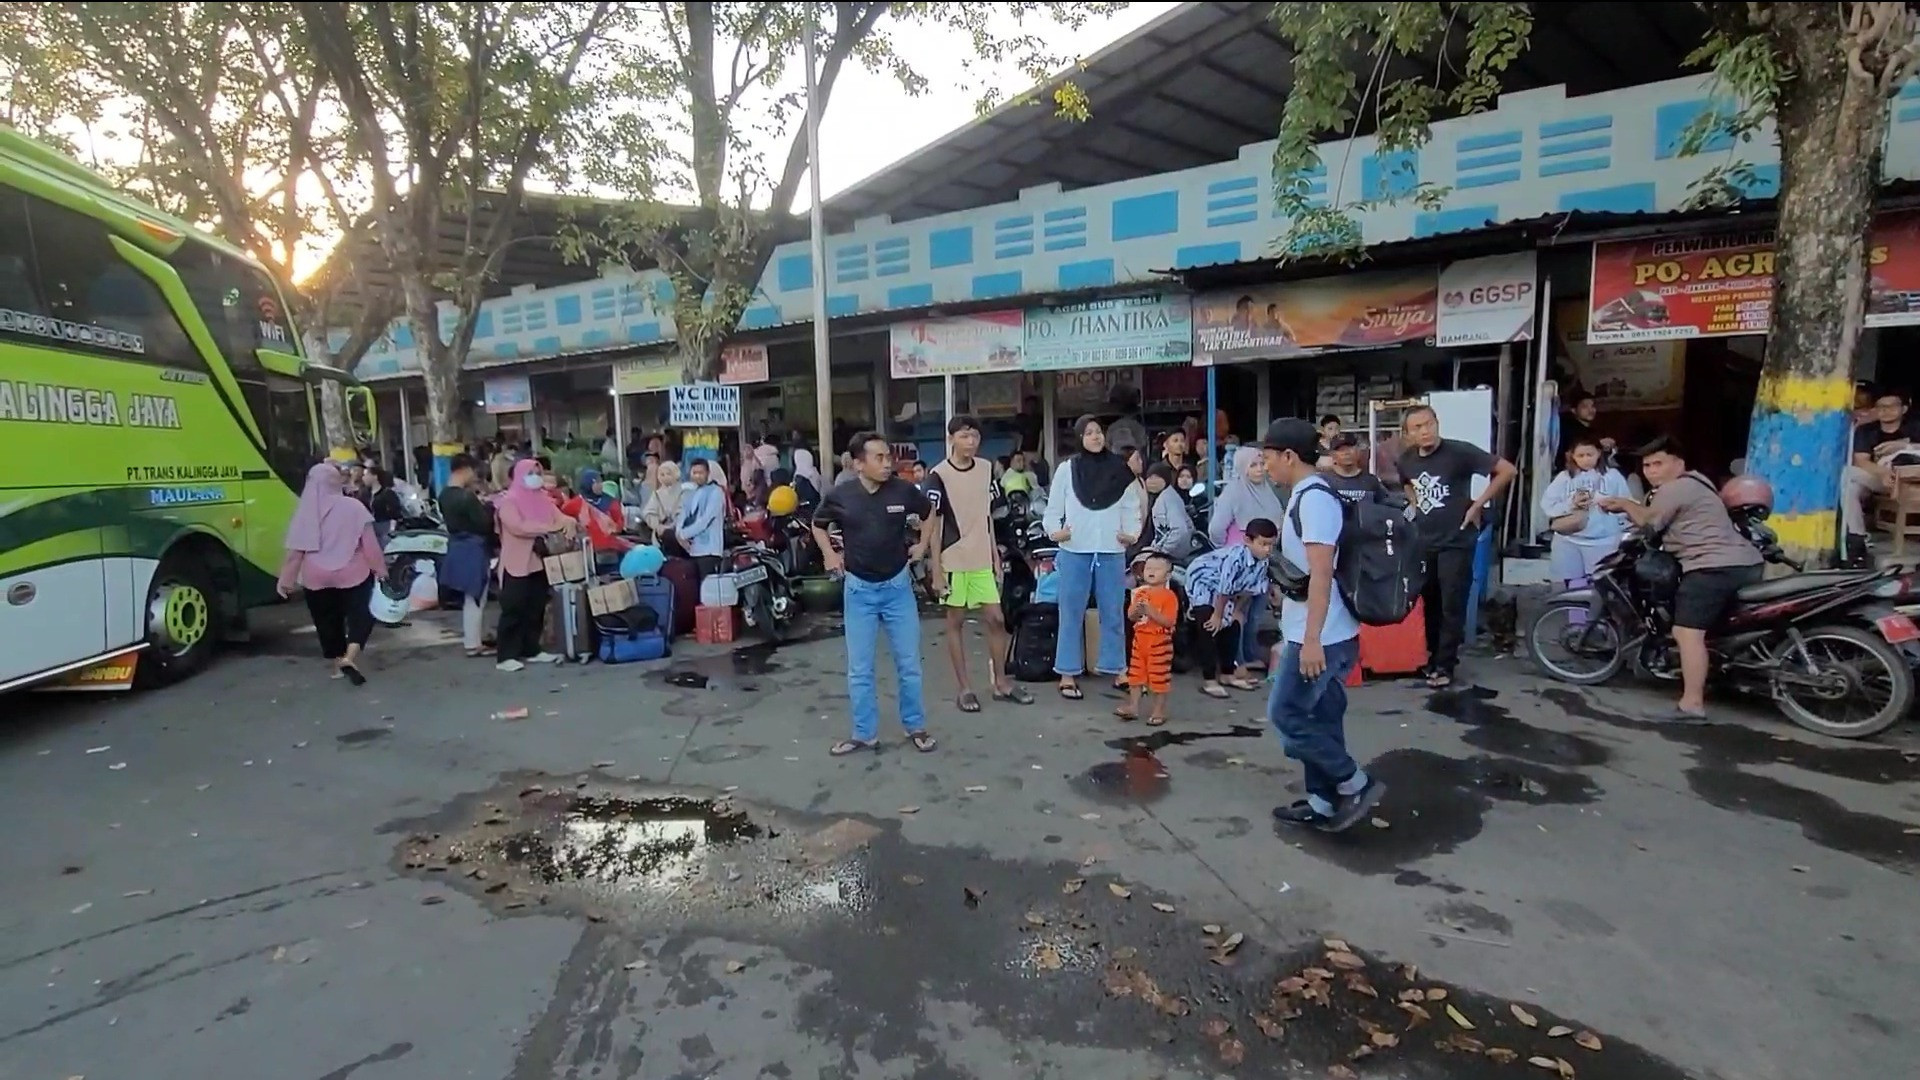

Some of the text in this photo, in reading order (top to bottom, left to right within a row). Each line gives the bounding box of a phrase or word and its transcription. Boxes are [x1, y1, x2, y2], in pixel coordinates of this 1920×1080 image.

[1653, 233, 1759, 256] PERWAKILAN
[1634, 260, 1690, 285] PO.
[1469, 282, 1532, 304] GGSP
[1054, 302, 1086, 313] AGEN
[1089, 300, 1114, 311] BUS
[1028, 320, 1057, 339] PO.
[1070, 310, 1169, 336] SHANTIKA
[1359, 307, 1435, 335] Surya
[1204, 341, 1220, 352] TAK
[703, 386, 737, 401] UMUM
[0, 380, 182, 430] ALINGGA JAYA
[127, 466, 239, 480] PT. TRANS KALINGGA JAYA
